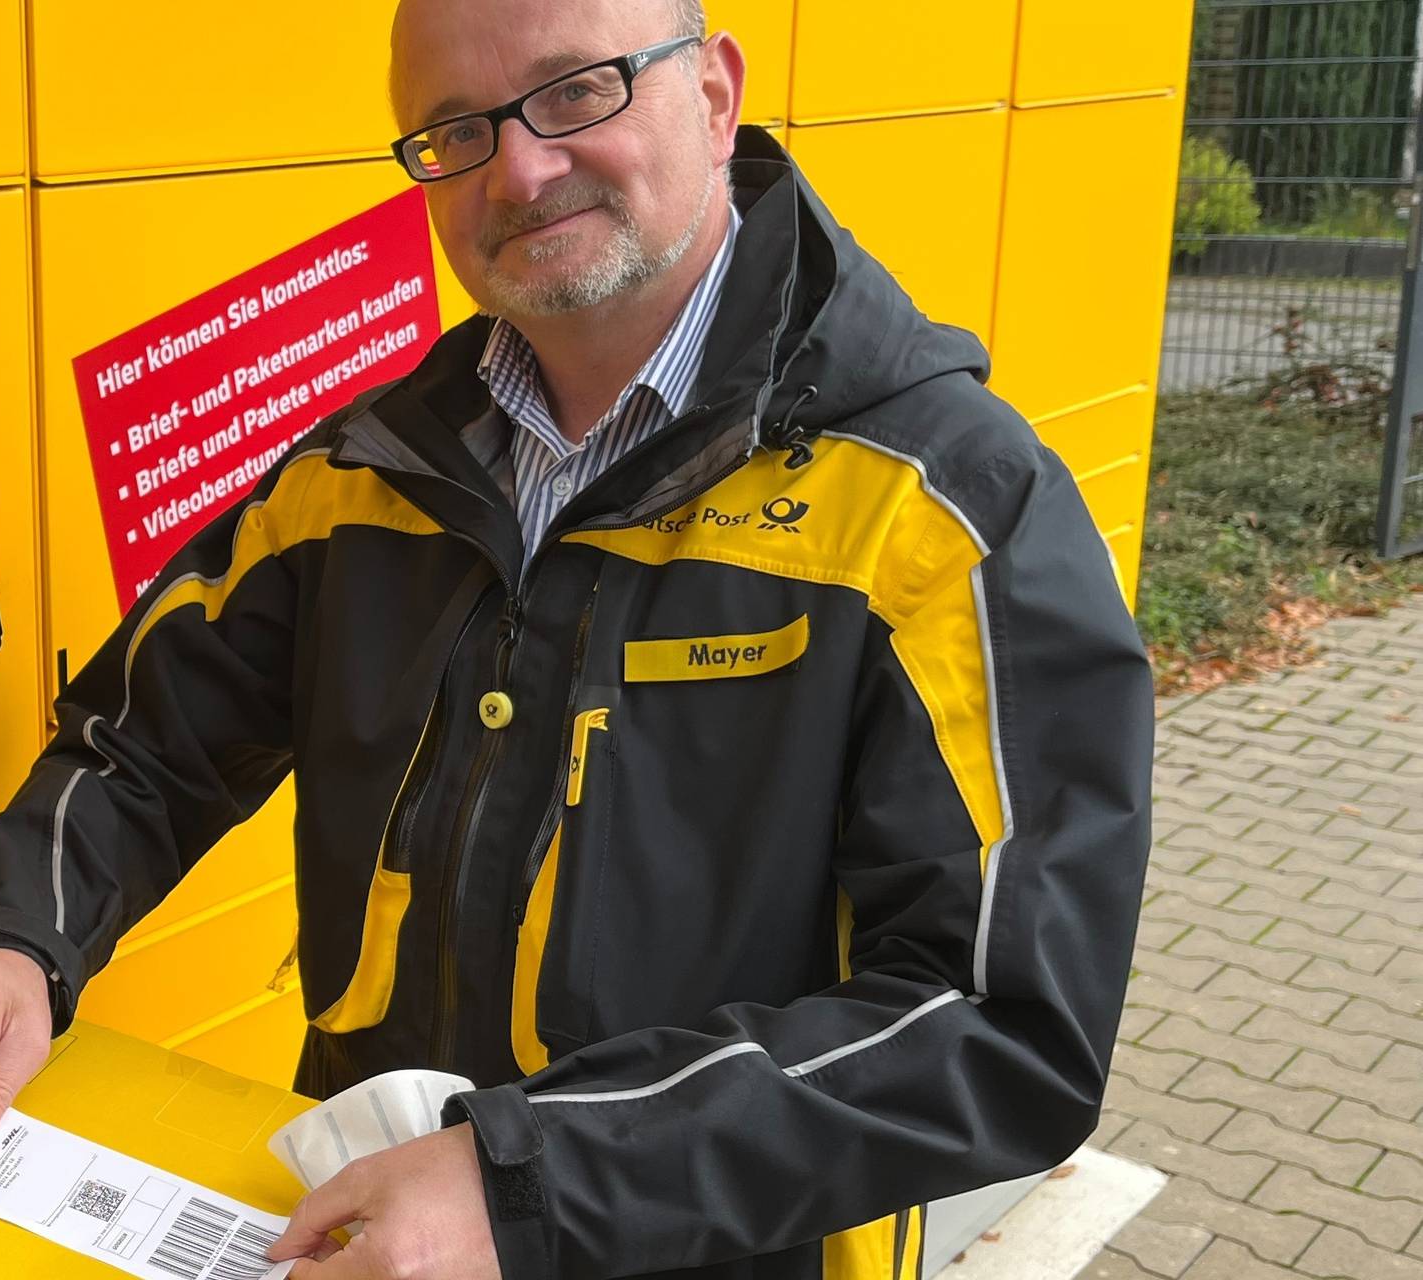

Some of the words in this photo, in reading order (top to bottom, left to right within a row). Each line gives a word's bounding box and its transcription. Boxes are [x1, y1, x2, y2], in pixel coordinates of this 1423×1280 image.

[95, 354, 144, 398] Hier
[145, 315, 225, 372] können
[227, 296, 261, 330] Sie
[261, 240, 369, 309] kontaktlos:
[127, 401, 188, 453] Brief-
[191, 374, 232, 417] und
[233, 313, 359, 394] Paketmarken
[361, 275, 423, 323] kaufen
[135, 444, 201, 497] Briefe
[202, 415, 242, 459] und
[243, 386, 310, 437] Pakete
[311, 321, 419, 396] verschicken
[701, 507, 751, 527] Post
[688, 643, 767, 670] Mayer
